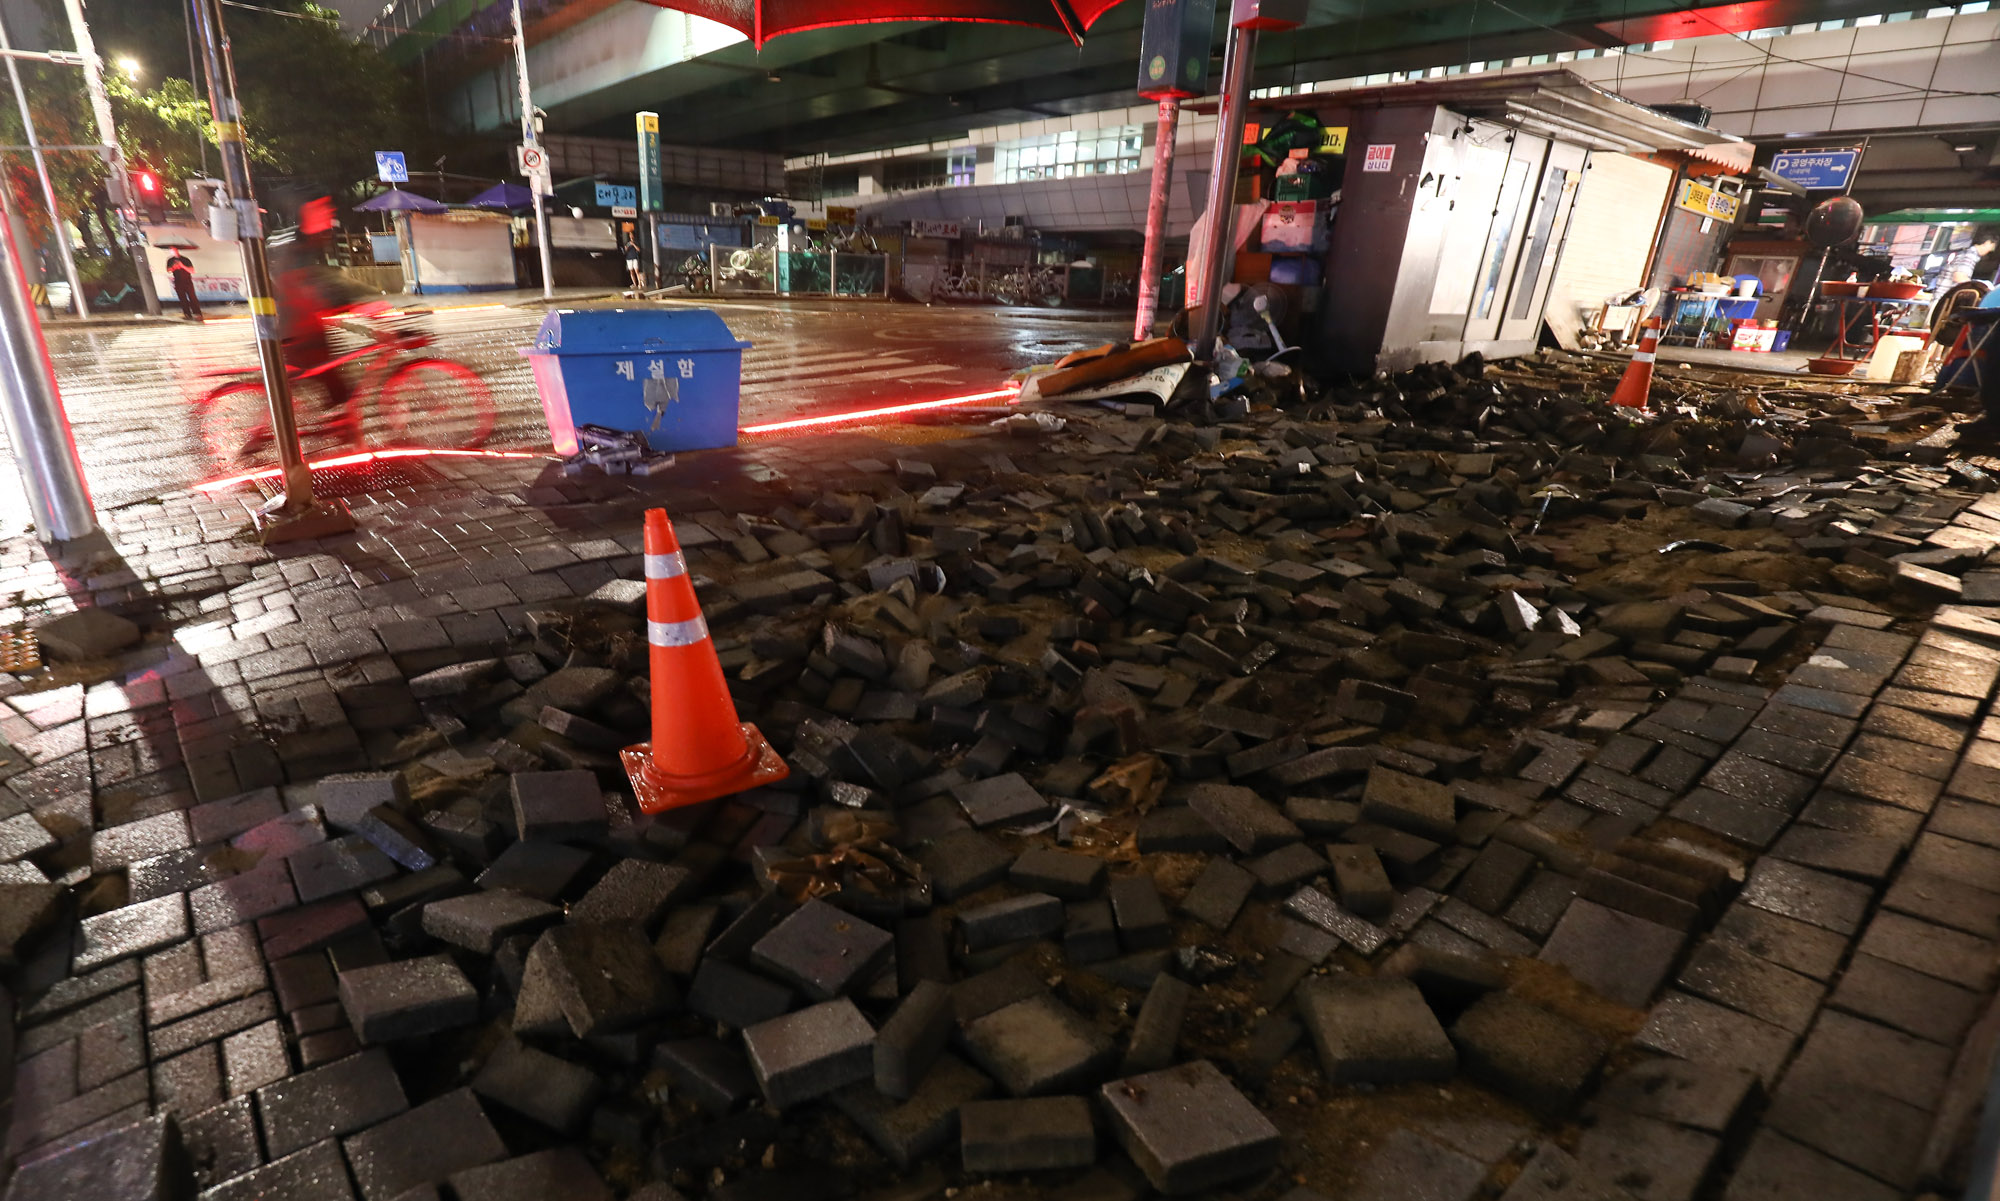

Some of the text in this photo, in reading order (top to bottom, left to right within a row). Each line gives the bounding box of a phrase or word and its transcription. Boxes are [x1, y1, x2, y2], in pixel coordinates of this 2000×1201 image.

[1775, 159, 1789, 175] P
[1791, 157, 1833, 168] 공영주차장
[616, 359, 695, 381] 제설함
